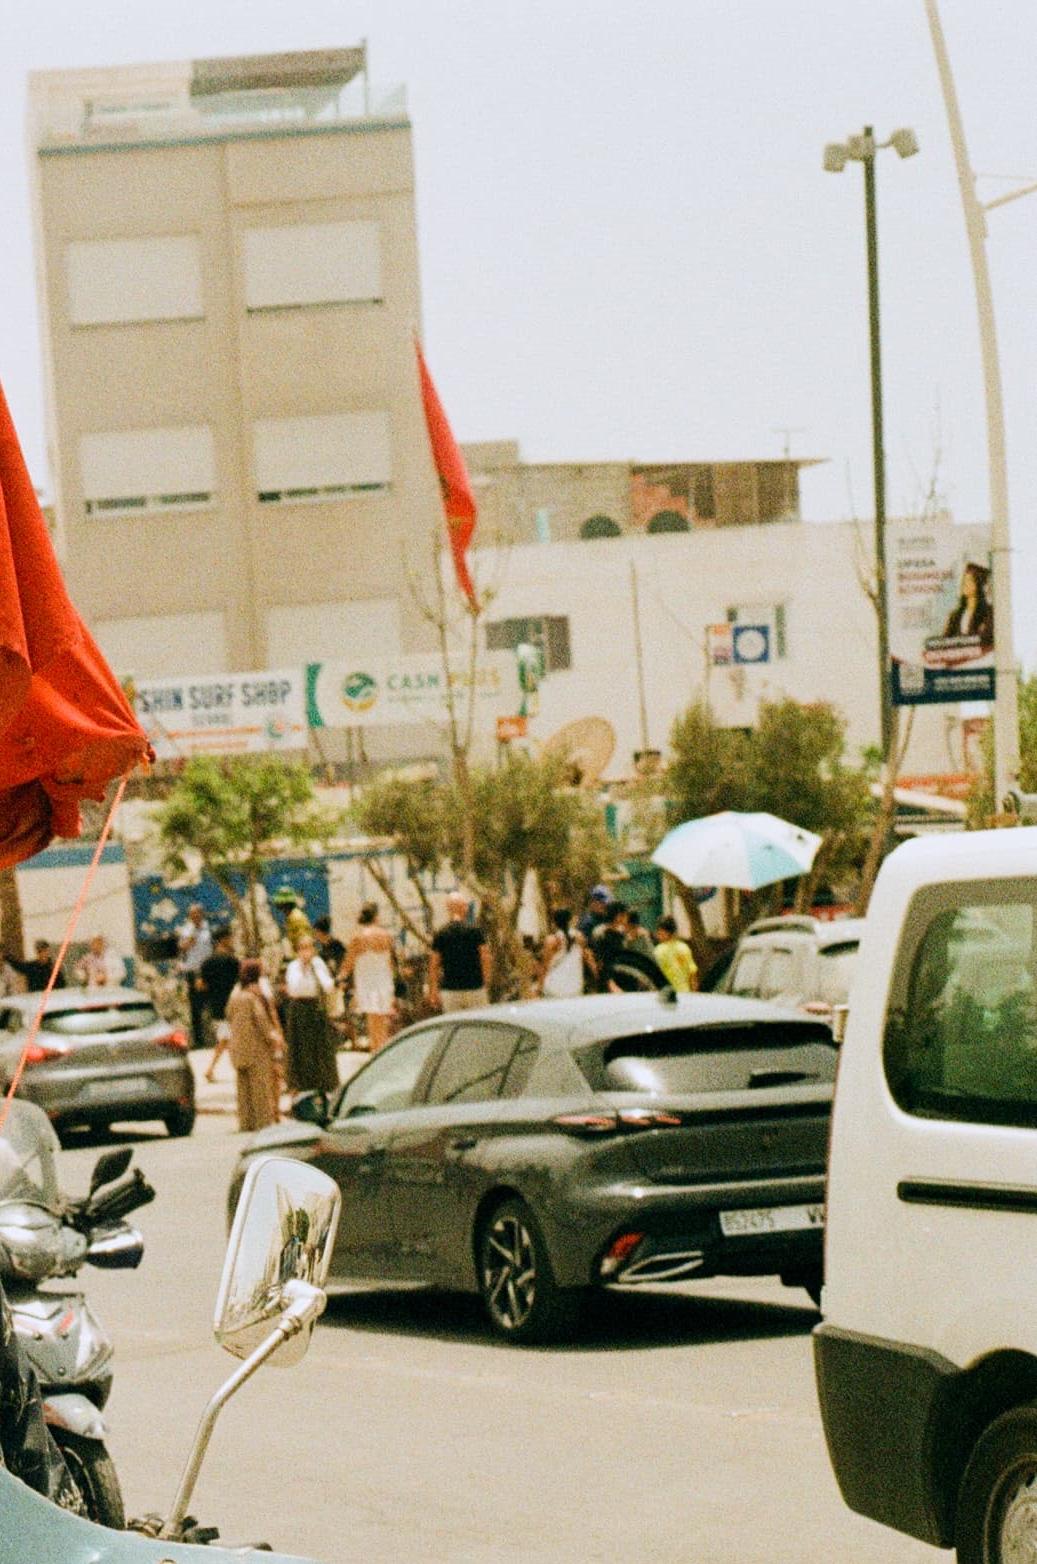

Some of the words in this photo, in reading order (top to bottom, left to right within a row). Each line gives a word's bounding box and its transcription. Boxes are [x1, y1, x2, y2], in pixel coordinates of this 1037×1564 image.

[387, 673, 440, 690] CASH
[189, 683, 234, 709] SURF
[241, 679, 292, 706] SHOP
